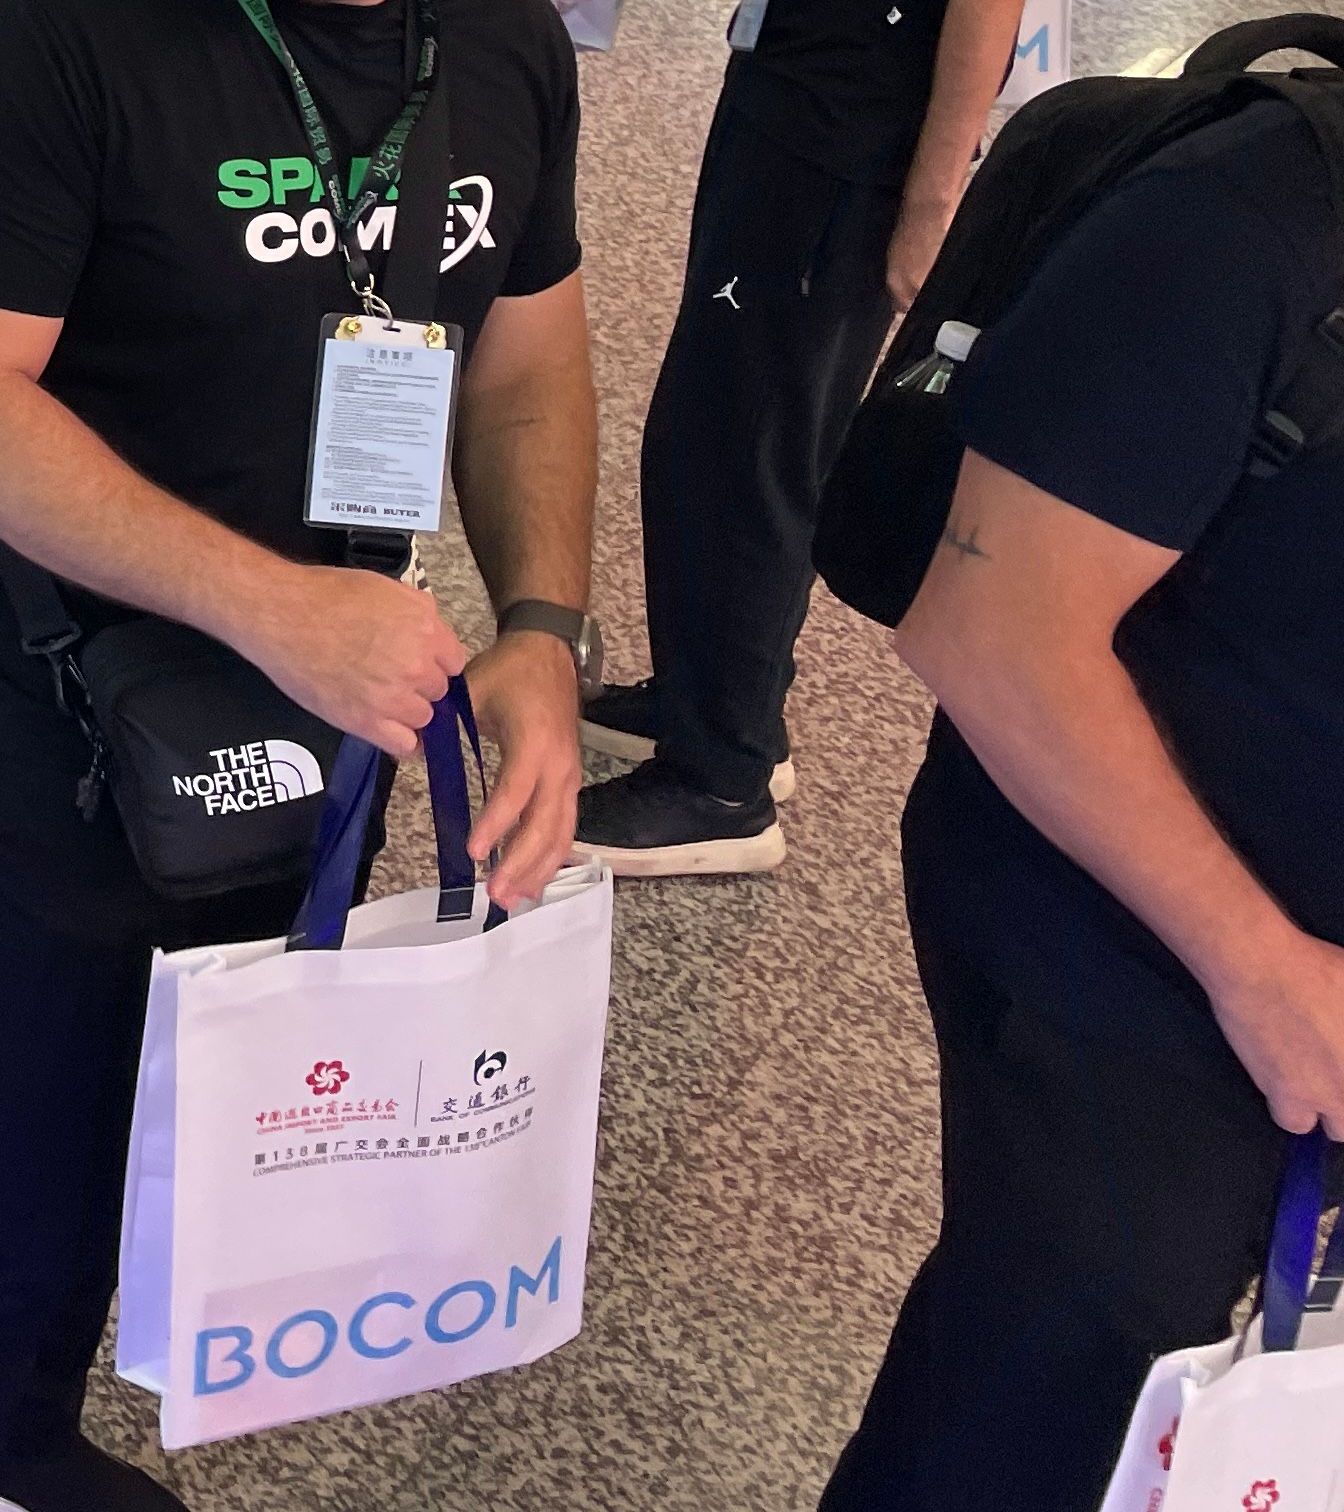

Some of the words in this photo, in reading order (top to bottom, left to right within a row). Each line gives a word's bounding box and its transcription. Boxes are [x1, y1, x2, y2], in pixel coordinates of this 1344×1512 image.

[383, 508, 421, 518] BUYER
[209, 741, 267, 772] THE
[172, 763, 271, 797] NORTH
[204, 784, 275, 816] FACE
[442, 1075, 531, 1114] 交通银行
[384, 1149, 427, 1159] PARTNER
[193, 1235, 562, 1396] BOCOM
